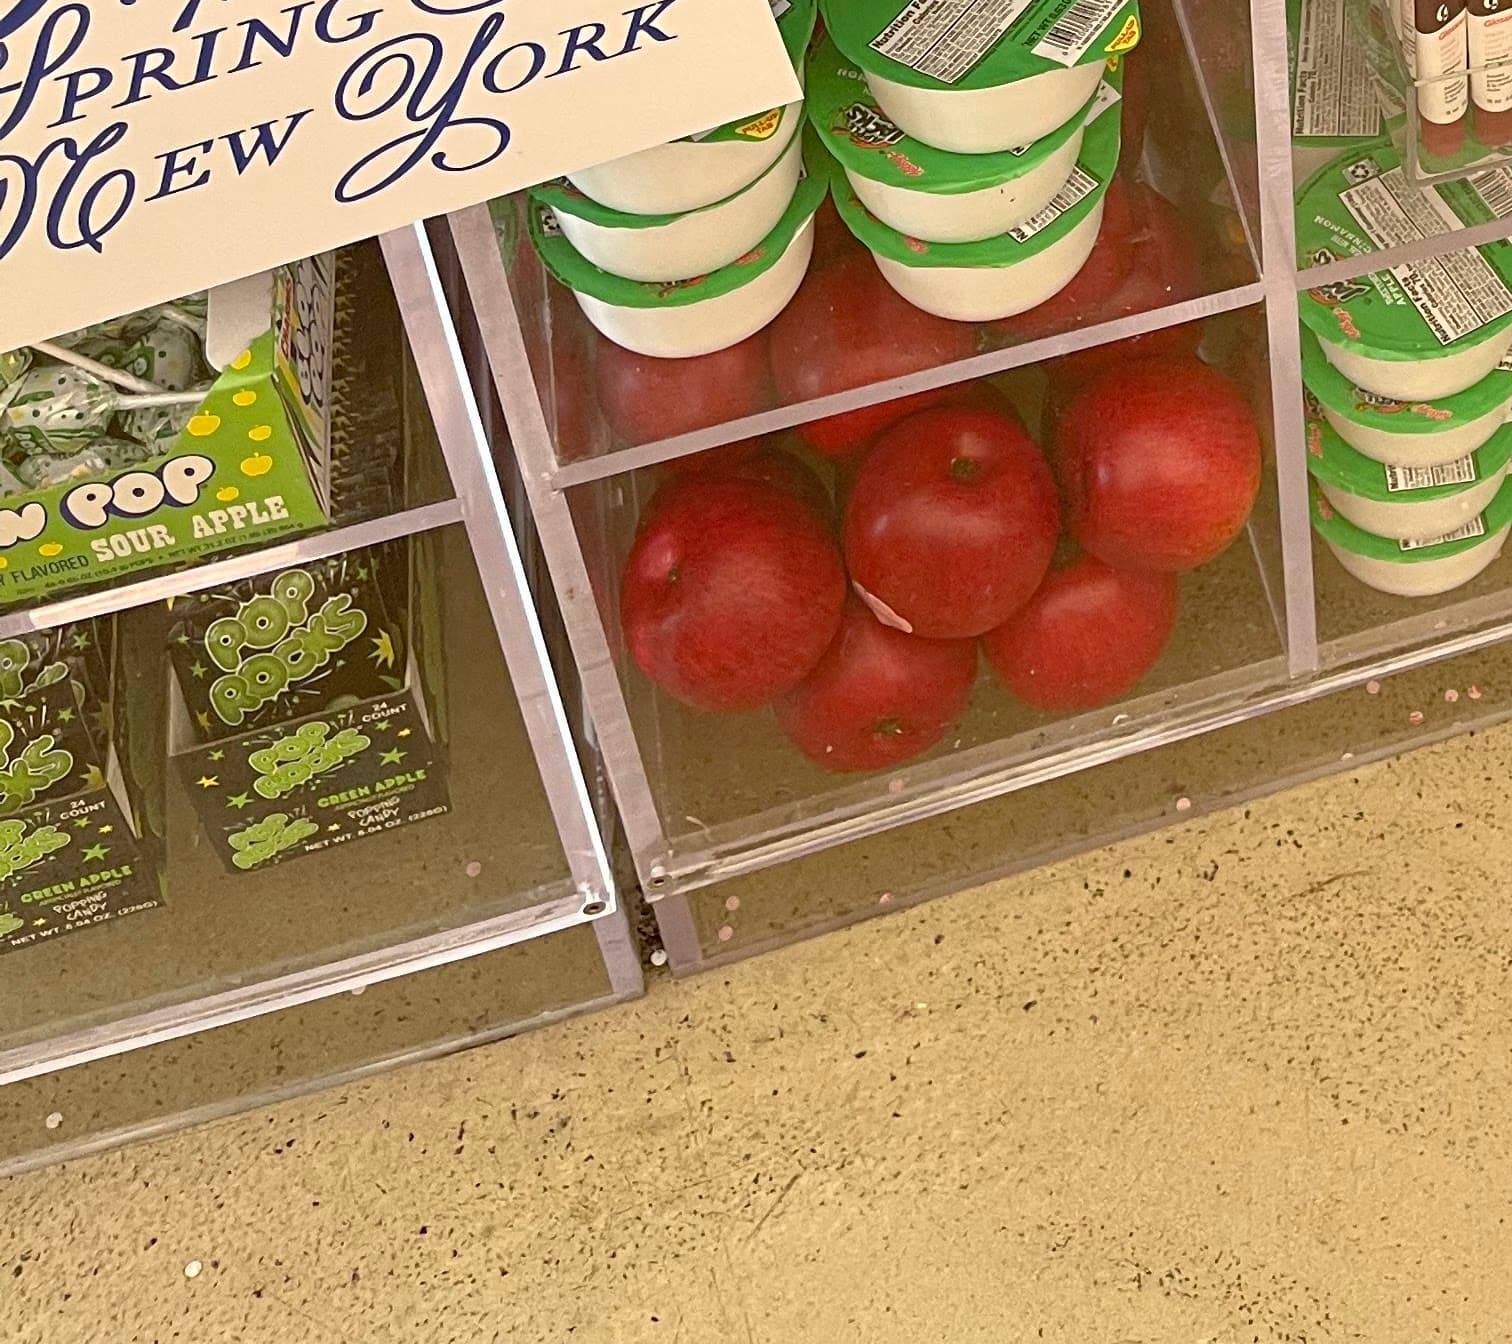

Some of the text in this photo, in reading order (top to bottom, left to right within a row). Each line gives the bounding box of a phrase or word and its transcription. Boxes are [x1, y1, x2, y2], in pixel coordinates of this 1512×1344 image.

[872, 9, 915, 51] Nutrition
[0, 108, 315, 258] NEW
[59, 453, 216, 531] POP
[89, 523, 176, 563] SOUR
[191, 494, 290, 539] APPLE
[12, 553, 90, 584] FLAVORED
[204, 568, 316, 672] POP
[209, 592, 369, 727] ROCKS
[361, 703, 408, 724] COUNT
[371, 701, 389, 713] 24
[248, 720, 331, 775] POP
[253, 727, 372, 800] ROCKS
[69, 798, 87, 810] 24
[316, 785, 371, 809] GREEN
[374, 769, 428, 793] APPLE
[59, 800, 107, 821] COUNT
[359, 807, 401, 828] CANDY
[19, 864, 134, 905] GREEN APPLE
[65, 901, 108, 922] CANDY
